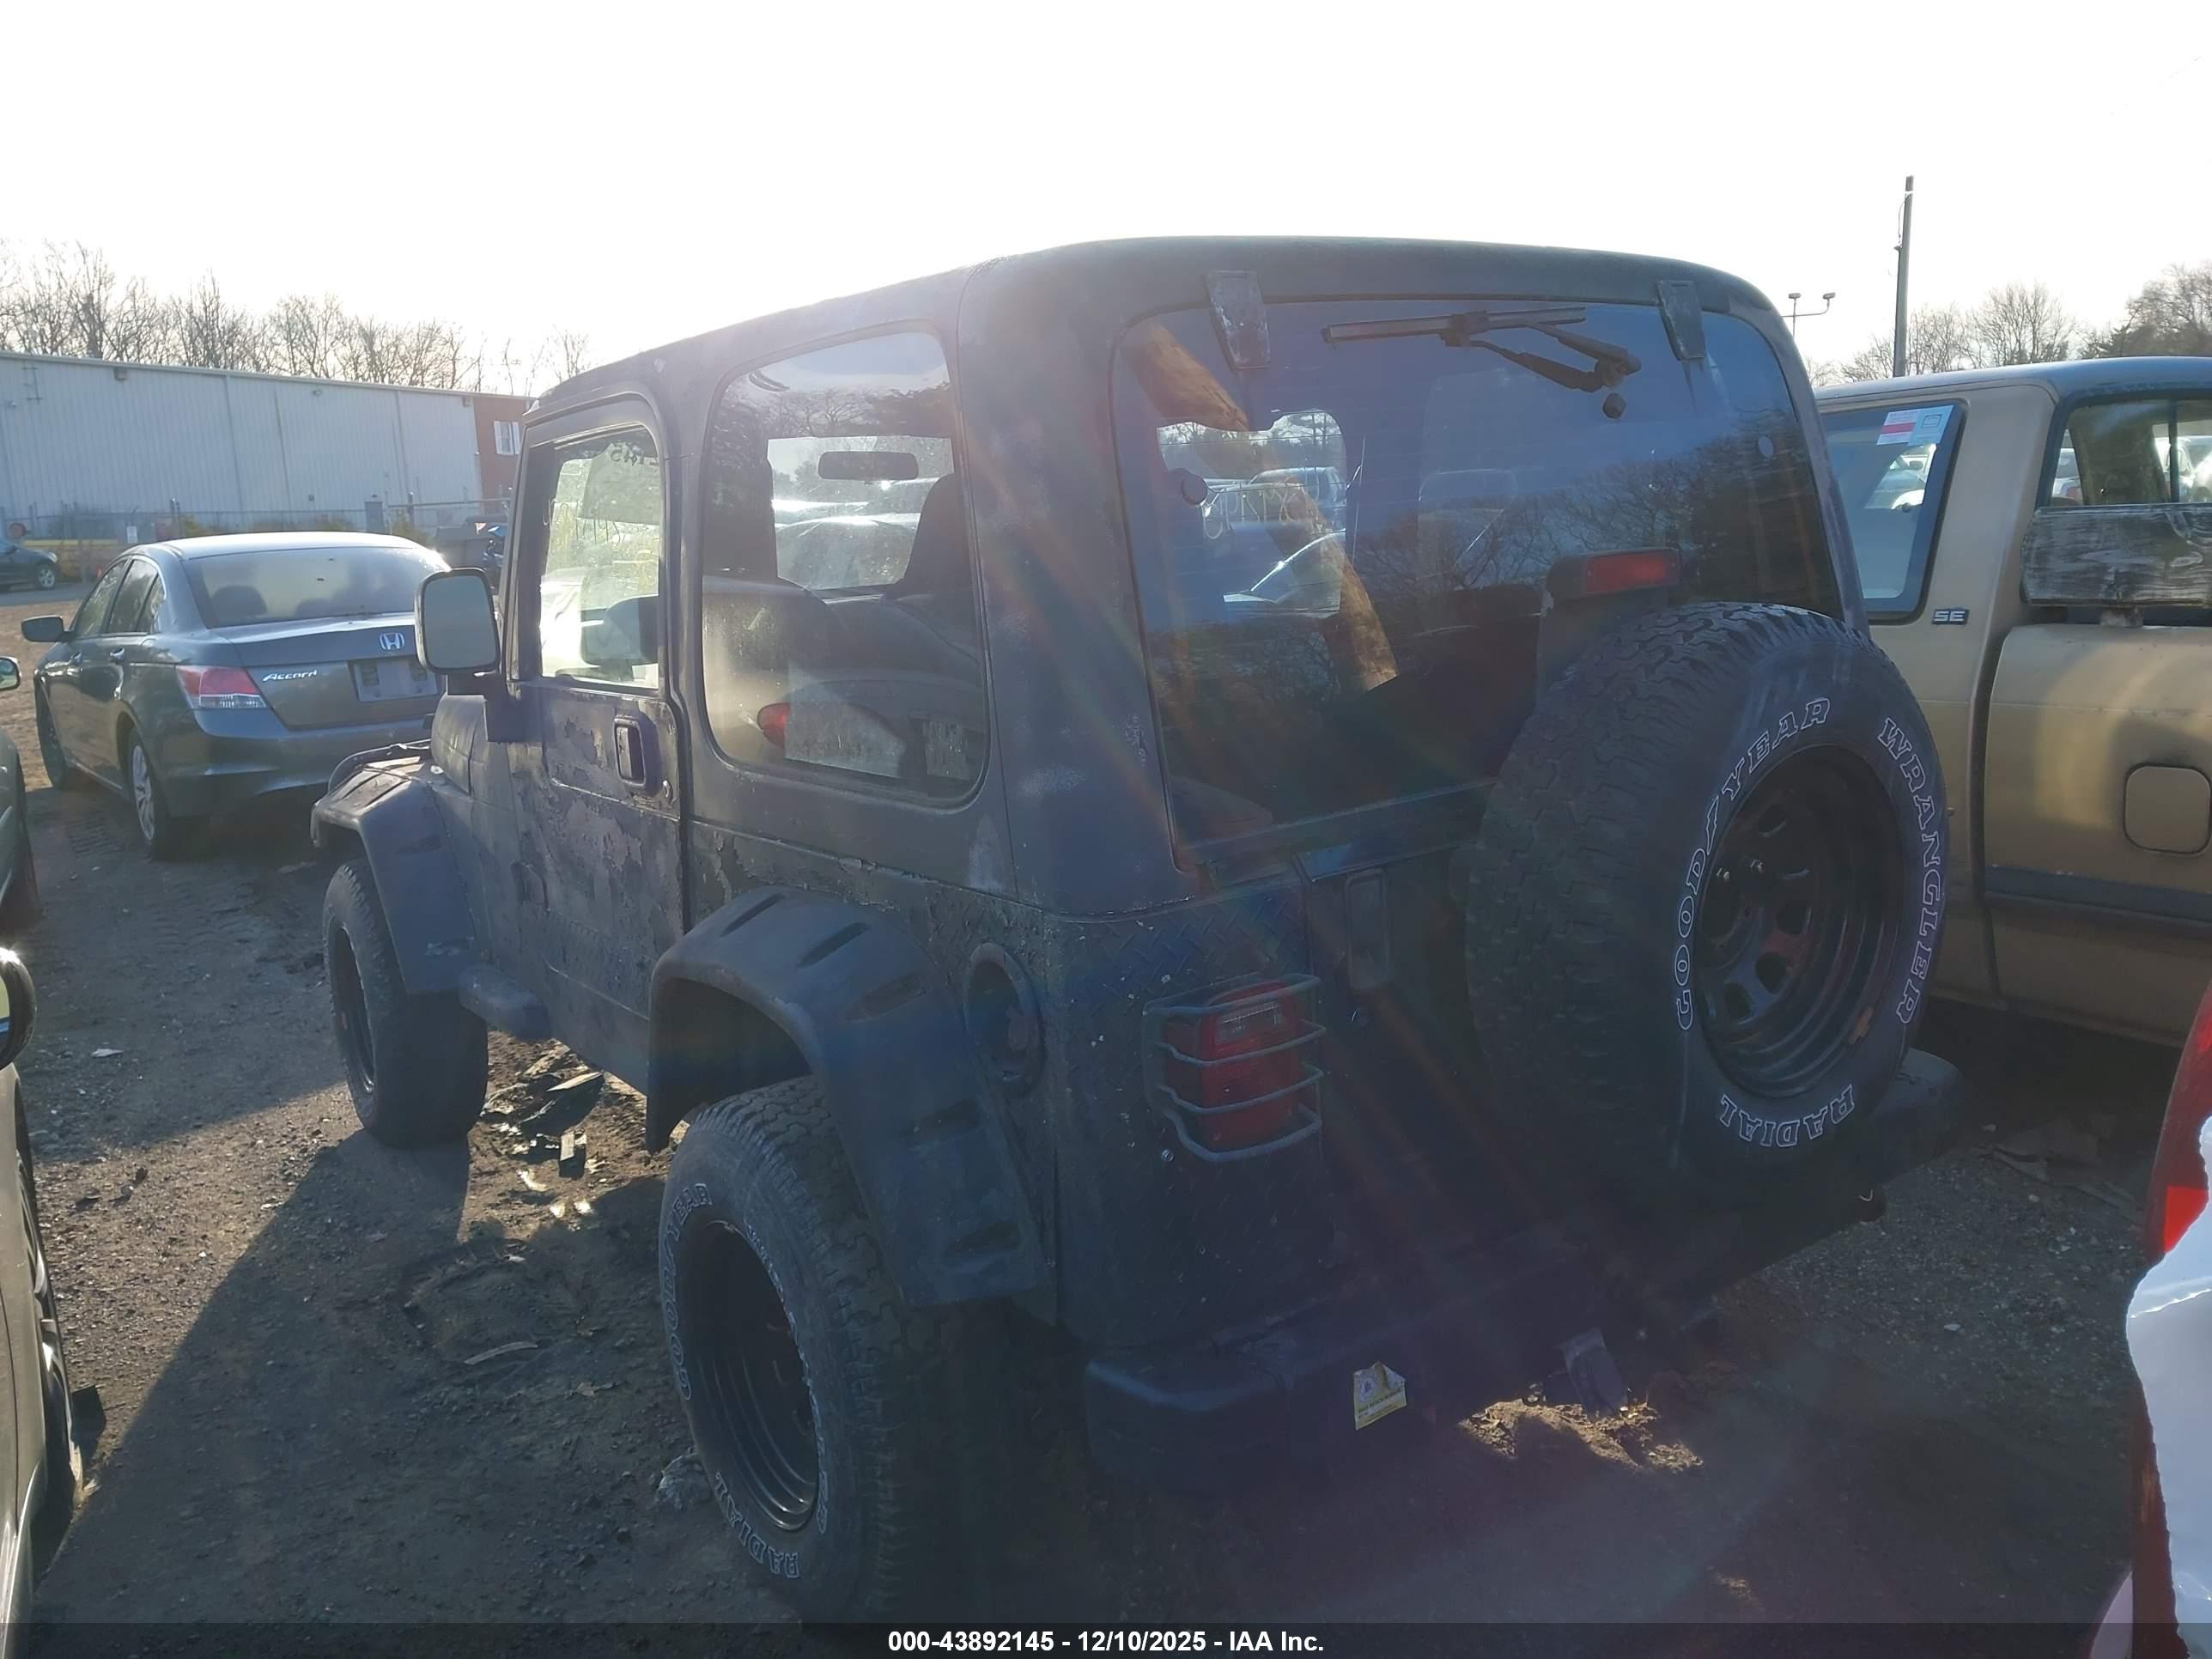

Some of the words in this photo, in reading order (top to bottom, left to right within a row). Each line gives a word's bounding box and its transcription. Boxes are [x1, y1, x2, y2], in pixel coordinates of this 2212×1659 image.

[1933, 610, 1966, 623] SE
[261, 670, 318, 682] Accord
[1877, 717, 1942, 1025] WRANGLER
[1719, 1084, 1856, 1148] RADIAL
[714, 1469, 802, 1579] RADIAL
